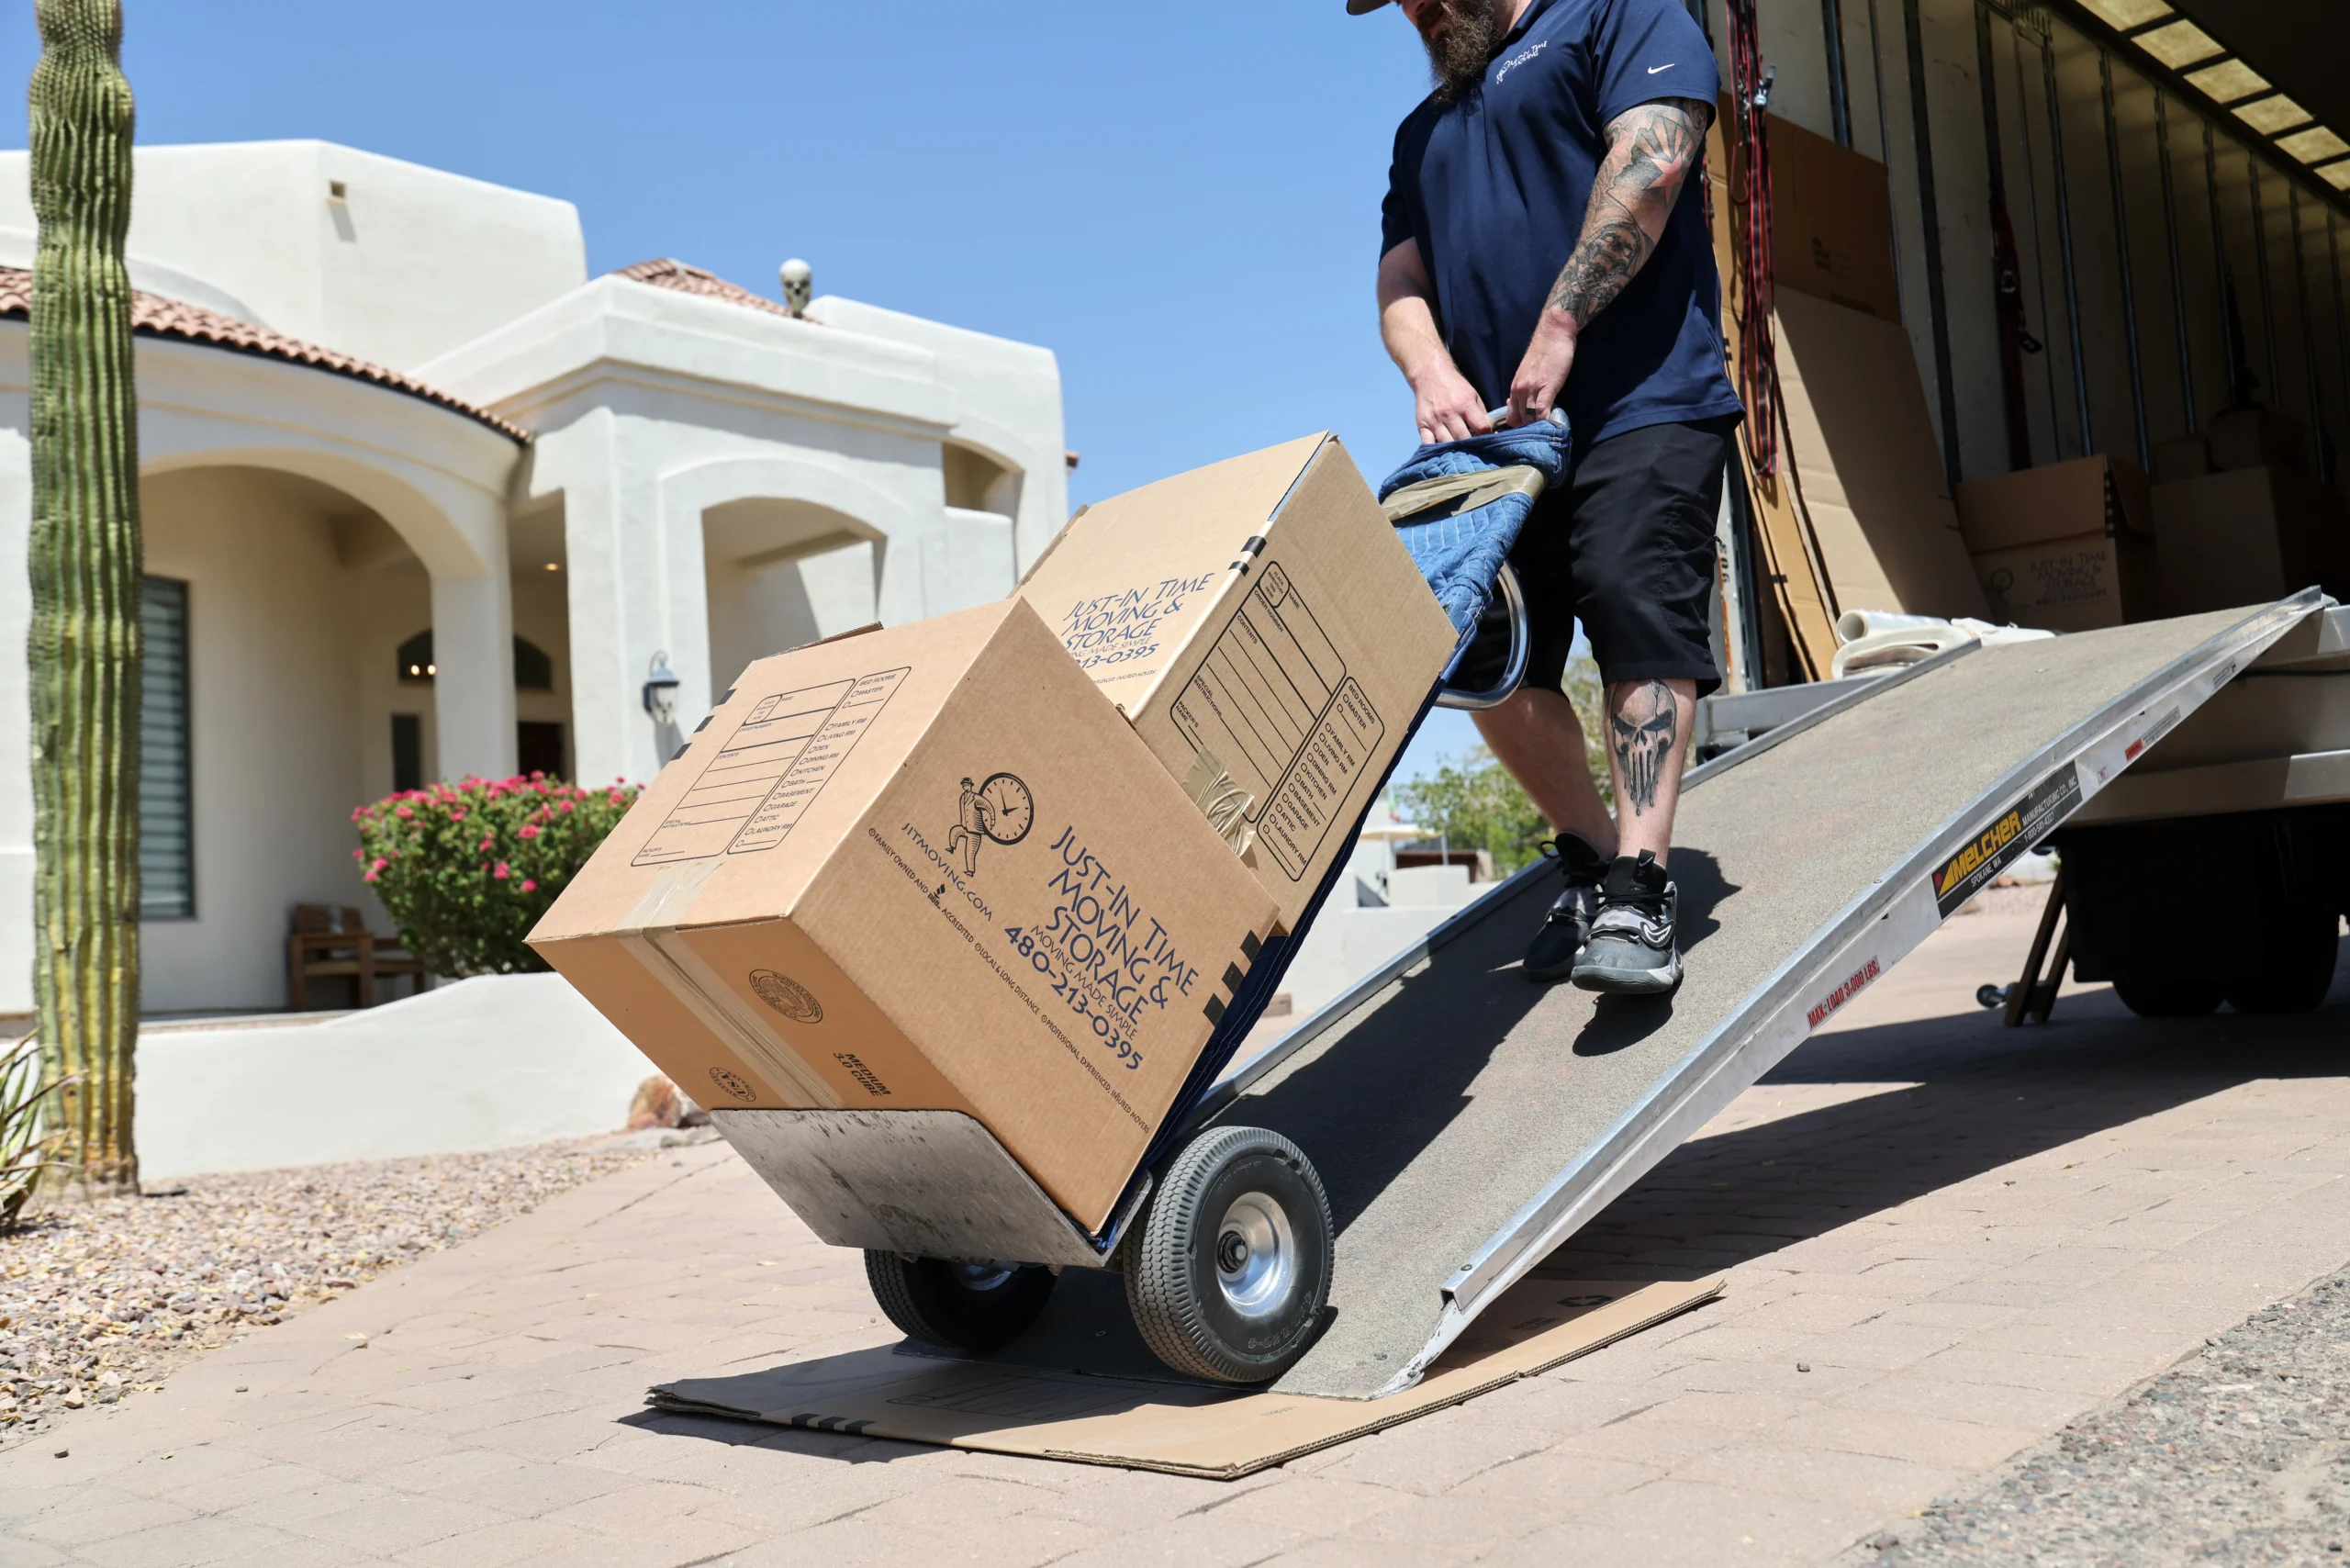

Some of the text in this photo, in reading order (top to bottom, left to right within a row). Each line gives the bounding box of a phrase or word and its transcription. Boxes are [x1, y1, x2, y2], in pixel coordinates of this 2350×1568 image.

[1062, 572, 1215, 622] JUST-IN TIME
[1254, 589, 1283, 633] ORDER NUMBER
[1288, 592, 1301, 610] NAME
[1060, 593, 1186, 636] MOVING &
[1237, 614, 1259, 644] CONTENTS
[1066, 617, 1163, 650] STORAGE
[1090, 643, 1118, 655] MADE
[1118, 635, 1153, 650] SIMPLE
[857, 686, 885, 697] MASTER
[858, 673, 897, 687] BED ROOMS
[1196, 674, 1214, 699] SPECIAL
[1175, 704, 1189, 722] NAME
[1193, 678, 1223, 717] INSTRUCTIONS
[1348, 684, 1376, 724] BED ROOMS
[832, 717, 867, 730] FAMILY RM
[1178, 700, 1199, 728] PACKER'S
[1347, 701, 1367, 731] MASTER
[813, 744, 830, 753] DEN
[822, 729, 856, 741] LIVING RM
[1329, 730, 1356, 767] FAMILY RM
[797, 765, 826, 776] KITCHEN
[805, 752, 840, 764] DINING RM
[1317, 749, 1330, 767] DEN
[1324, 740, 1348, 775] LIVING RM
[788, 778, 807, 788] BATH
[1299, 779, 1314, 800] BATH
[1304, 768, 1327, 801] KITCHEN
[1311, 759, 1337, 796] DINING RM
[768, 801, 798, 812] GARAGE
[779, 787, 815, 800] BASEMENT
[1292, 790, 1321, 827] BASEMENT
[2021, 789, 2060, 827] MANUFACTURING
[751, 822, 794, 836] LAUNDRY RM
[761, 813, 780, 823] ATTIC
[1281, 811, 1297, 833] ATTIC
[1287, 801, 1310, 832] GARAGE
[1274, 822, 1308, 867] LAUNDRY RM
[901, 822, 992, 922] JITMOVING.COM
[1992, 856, 2002, 870] WA
[1049, 825, 1200, 997] JUST-IN TIME
[1047, 867, 1171, 1010] MOVING &
[1045, 905, 1149, 1025] STORAGE
[873, 833, 896, 857] FAMILY
[893, 855, 916, 879] OWNED
[913, 878, 929, 893] AND
[941, 907, 975, 943] ACCREDITED
[979, 947, 997, 969] LOCAL
[1000, 970, 1015, 990] LONG
[1014, 985, 1041, 1015] DISTANCE
[1111, 1089, 1132, 1114] INSURED
[1130, 1111, 1150, 1134] MOVERS
[1003, 926, 1144, 1070] 480-213-0395
[1030, 924, 1138, 1041] MOVING MADE SIMPLE
[1807, 1003, 1828, 1028] MAX.
[1826, 987, 1845, 1013] LOAD
[1863, 959, 1881, 981] LBS.
[833, 1052, 883, 1097] 3.0 CUBE
[845, 1053, 892, 1095] MEDIUM
